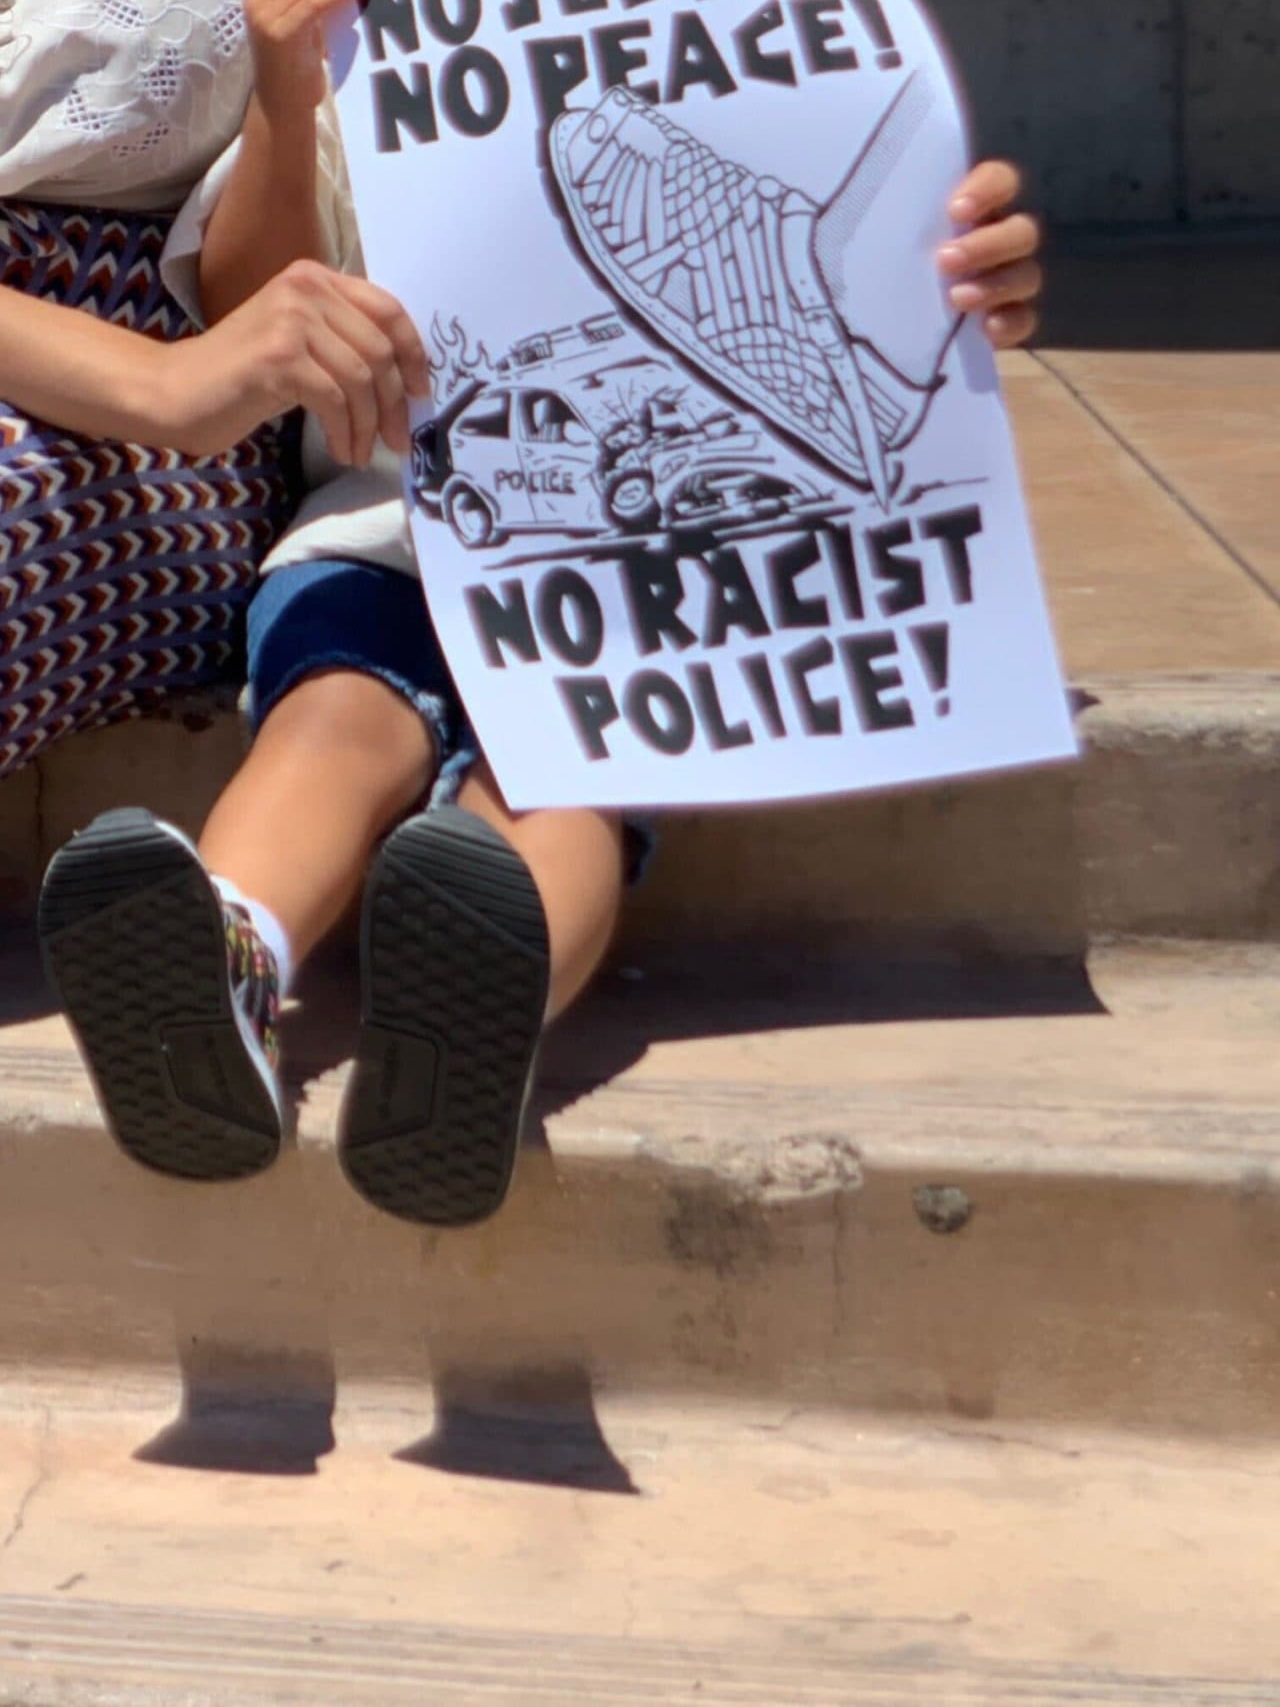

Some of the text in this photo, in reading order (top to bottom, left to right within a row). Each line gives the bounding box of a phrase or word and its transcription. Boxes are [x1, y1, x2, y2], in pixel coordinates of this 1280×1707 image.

[370, 44, 511, 154] NO
[494, 468, 576, 495] POLICE
[463, 504, 983, 668] NO RACIST
[554, 622, 951, 762] POLICE!
